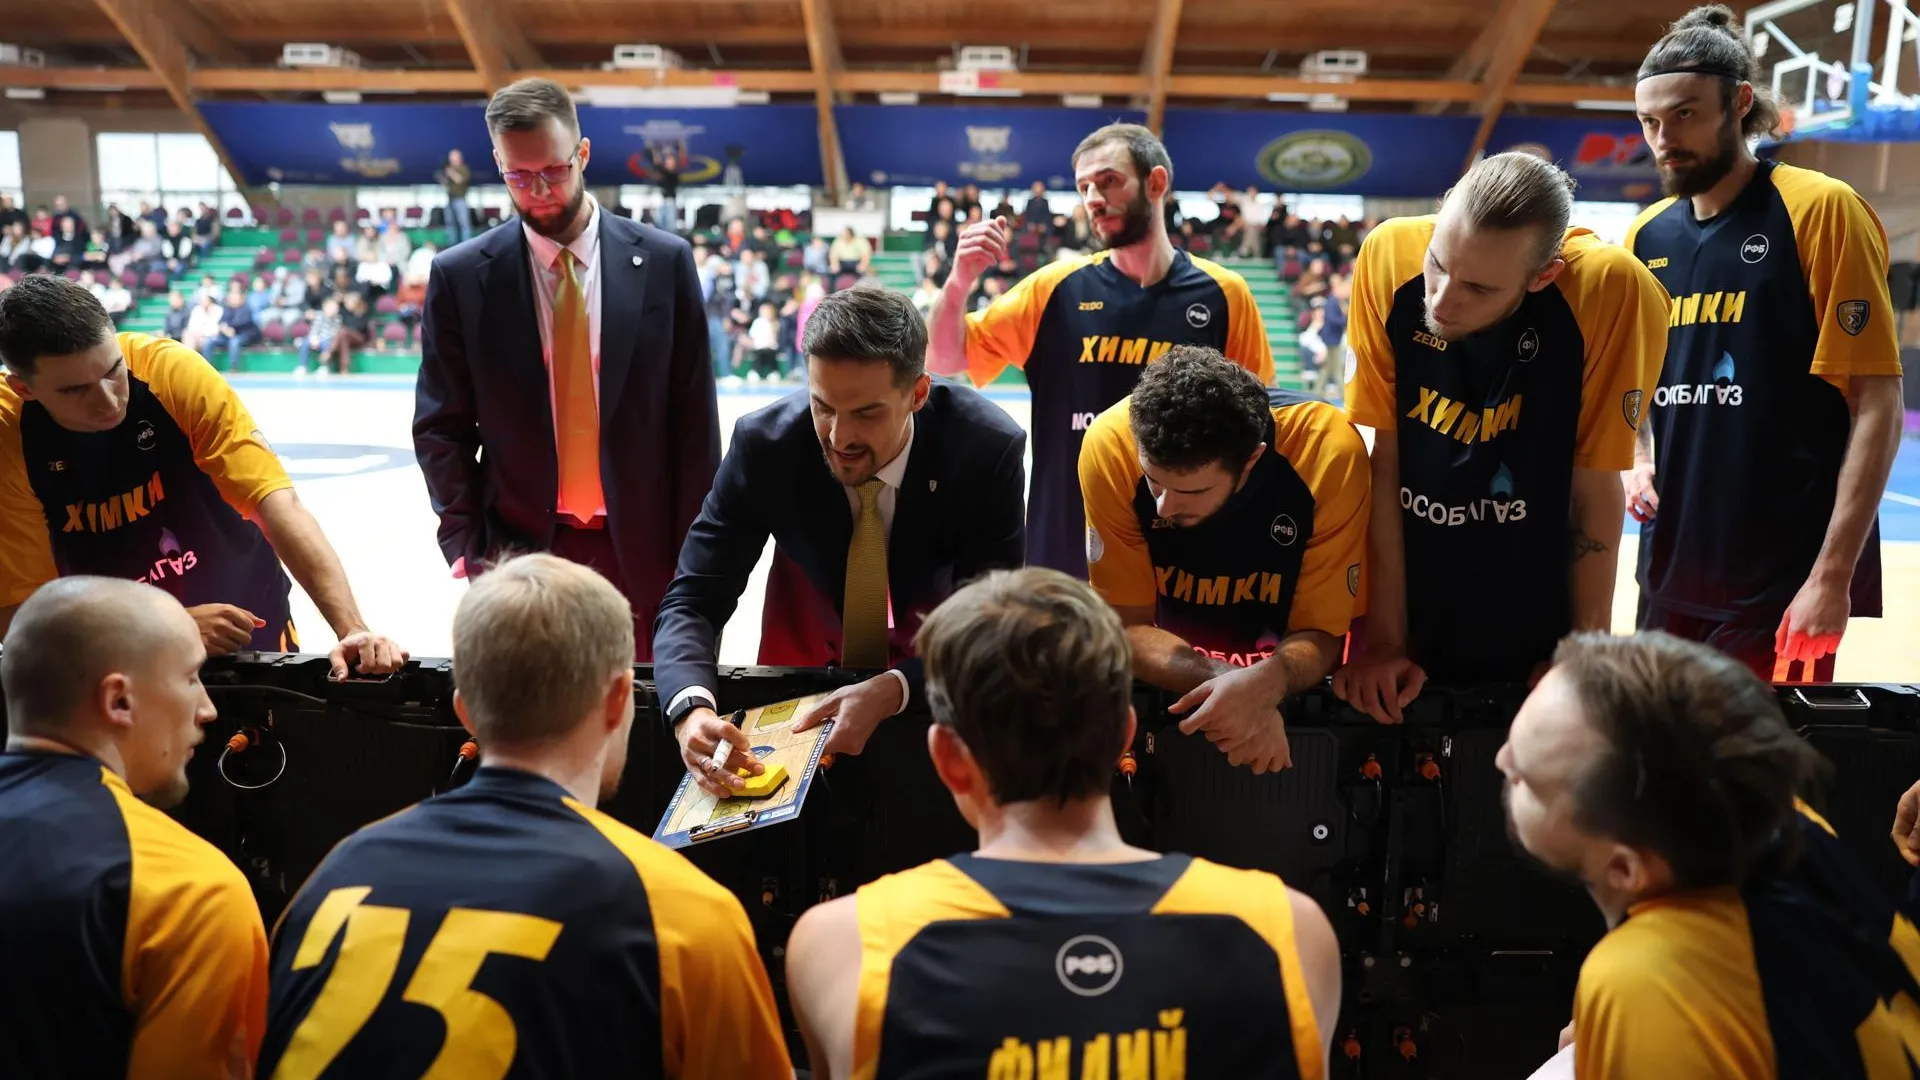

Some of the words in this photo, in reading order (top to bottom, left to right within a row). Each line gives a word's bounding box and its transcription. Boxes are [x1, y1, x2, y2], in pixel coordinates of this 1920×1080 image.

[1744, 244, 1766, 253] РФБ
[1647, 257, 1669, 269] ZEDO
[1669, 291, 1746, 328] ИМКИ
[1079, 335, 1172, 365] ХИМК
[1412, 330, 1448, 351] ZEDO
[1400, 486, 1527, 526] ОСОБЛГАЗ
[1274, 525, 1294, 536] РФБ
